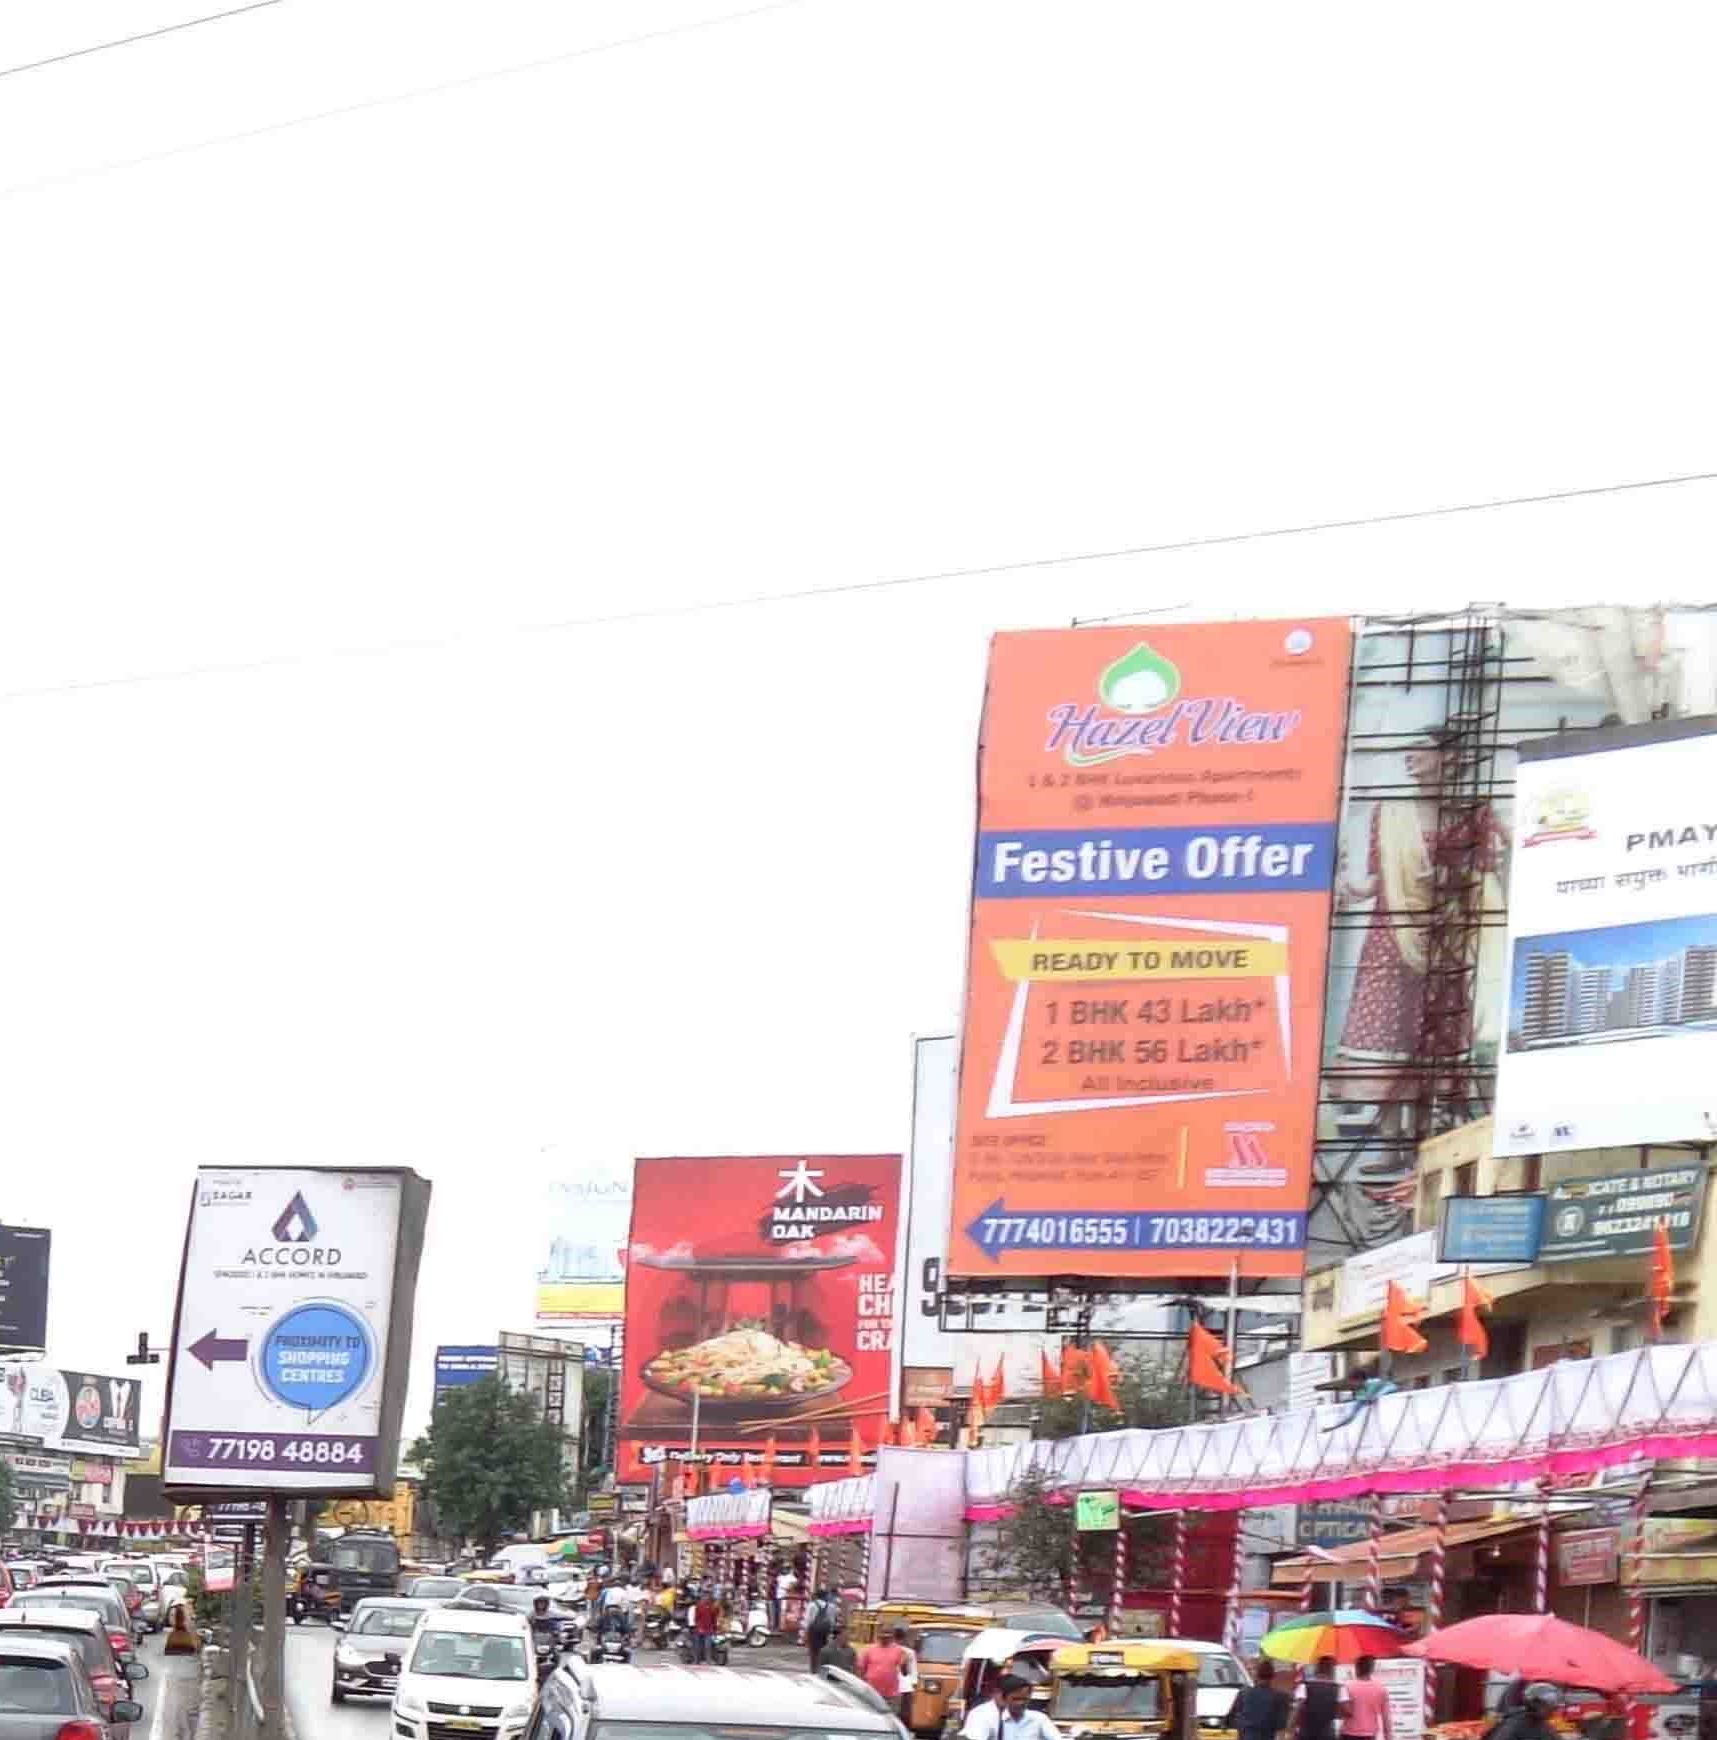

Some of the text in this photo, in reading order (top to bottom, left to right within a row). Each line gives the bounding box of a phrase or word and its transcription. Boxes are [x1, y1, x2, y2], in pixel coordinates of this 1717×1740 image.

[1045, 697, 1301, 760] Hazel View
[992, 835, 1313, 883] Festive Offer
[1032, 949, 1249, 972] READY TO MOVE
[1046, 1001, 1057, 1024] 1
[1069, 1000, 1128, 1024] BHK
[1137, 999, 1171, 1024] 43
[1041, 1041, 1061, 1065] 2
[1068, 1040, 1125, 1064] BHK
[1133, 1040, 1166, 1064] 56
[775, 1159, 825, 1203] 木
[773, 1206, 884, 1222] MANDARIN
[773, 1224, 815, 1239] OAK
[982, 1218, 1128, 1244] 7774016555
[241, 1248, 342, 1266] ACCORD
[277, 1351, 349, 1366] SHOPPING
[280, 1369, 344, 1383] CENTRES
[207, 1438, 364, 1464] 77198 48884
